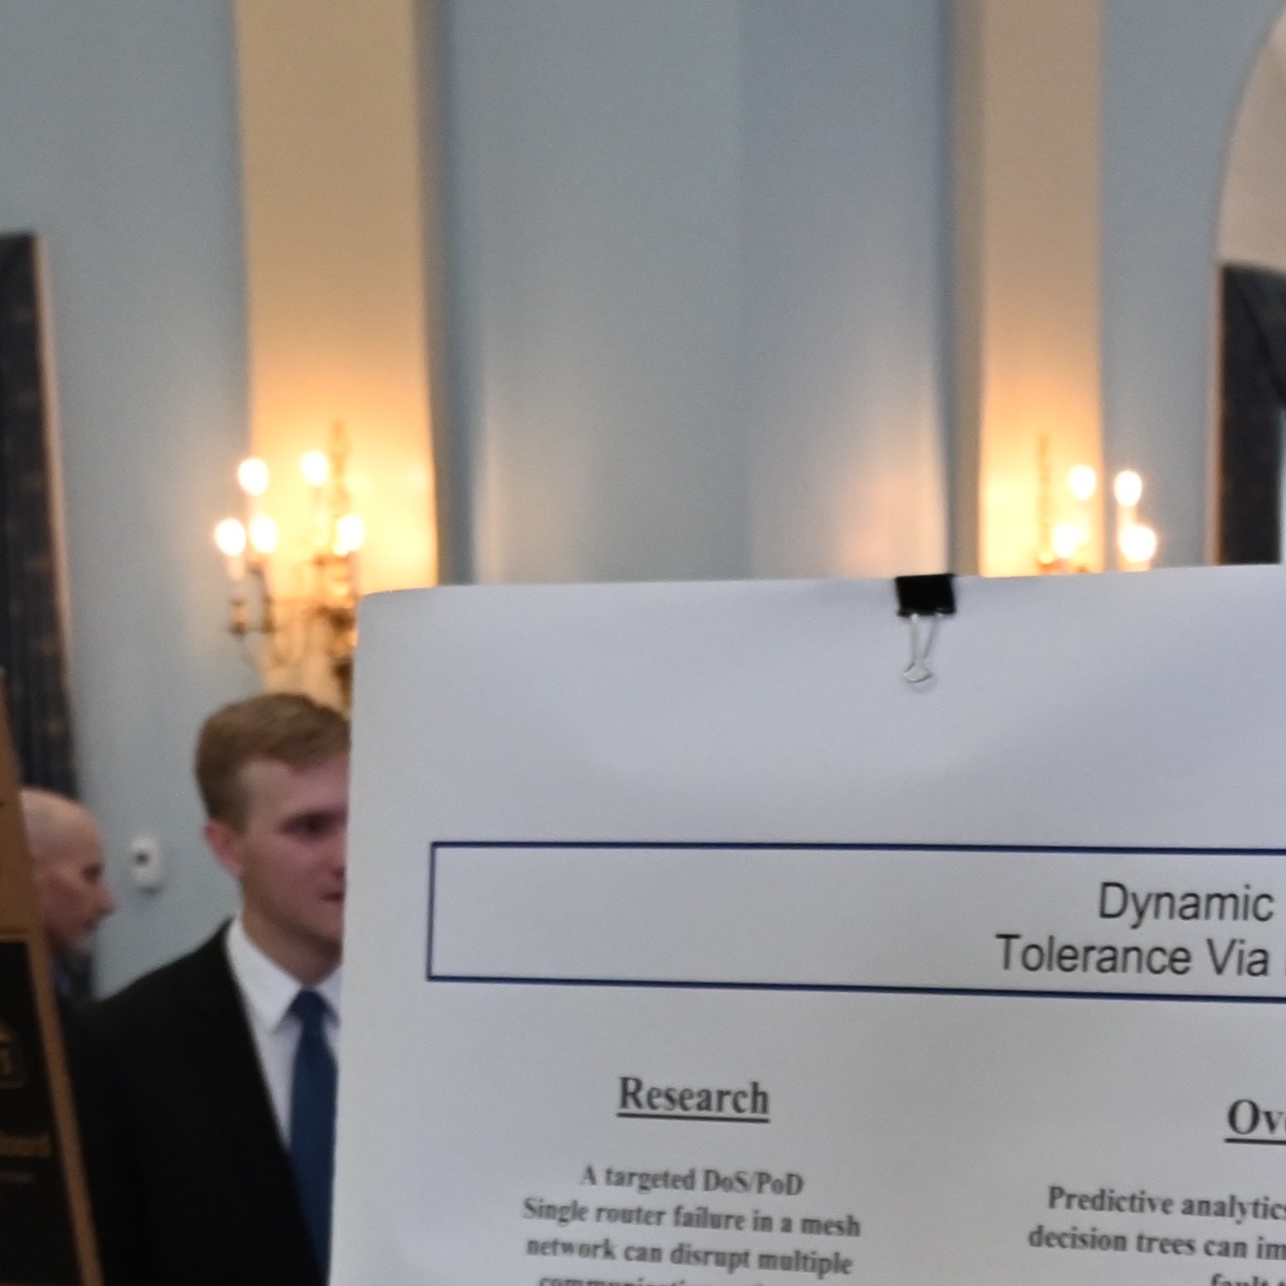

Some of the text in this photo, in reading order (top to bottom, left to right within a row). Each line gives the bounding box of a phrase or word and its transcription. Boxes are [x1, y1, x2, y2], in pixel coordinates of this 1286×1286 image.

[1098, 881, 1274, 929] Dynamic
[995, 934, 1192, 975] Tolerance
[1206, 938, 1268, 977] Via
[619, 1077, 769, 1115] Research
[581, 1165, 804, 1197] A targeted DoS/PoD
[523, 1198, 860, 1237] Single router failure in a mesh
[1048, 1186, 1173, 1216] Predictive
[526, 1237, 852, 1277] network can disrupt multiple
[1028, 1225, 1127, 1252] decision
[1135, 1232, 1196, 1256] trees
[1204, 1238, 1248, 1260] can
